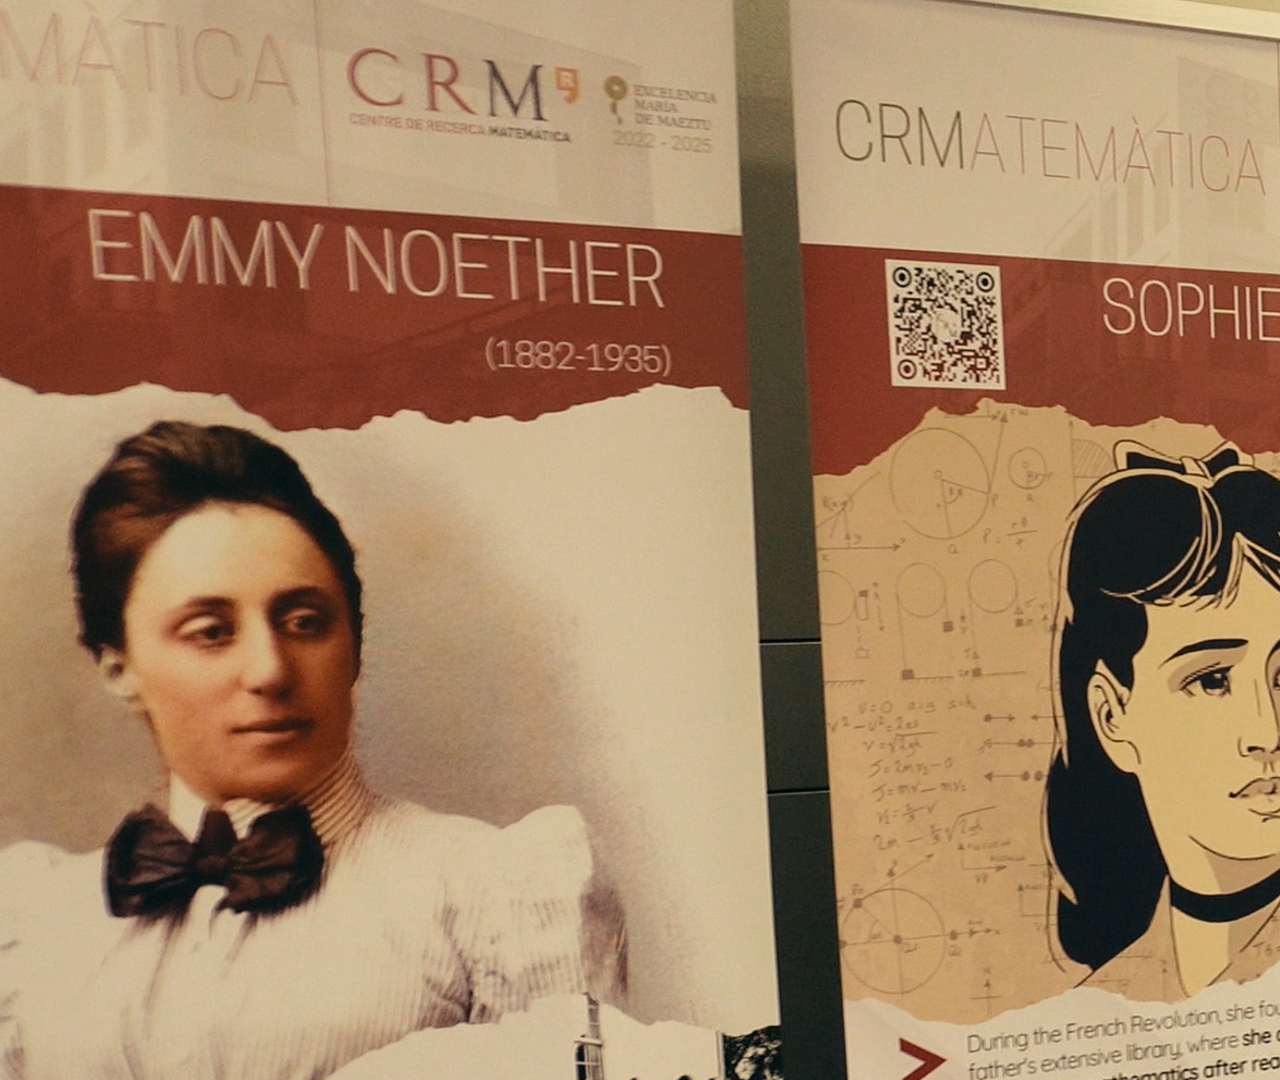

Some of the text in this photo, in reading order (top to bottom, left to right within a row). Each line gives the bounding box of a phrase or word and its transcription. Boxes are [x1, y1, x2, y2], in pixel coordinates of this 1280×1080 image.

[347, 47, 548, 121] CRM
[633, 84, 717, 103] EXCELENCIA
[349, 112, 402, 129] CENTRE
[404, 117, 424, 131] DE
[426, 118, 485, 135] RECERCA
[634, 112, 712, 130] DE MAEZTU
[613, 129, 714, 154] 2022 2025
[835, 98, 1268, 197] CRMATEMÀTICA
[87, 207, 666, 308] EMMY NOETHER
[485, 338, 672, 376] (1882-1935)
[1203, 1059, 1247, 1079] after
